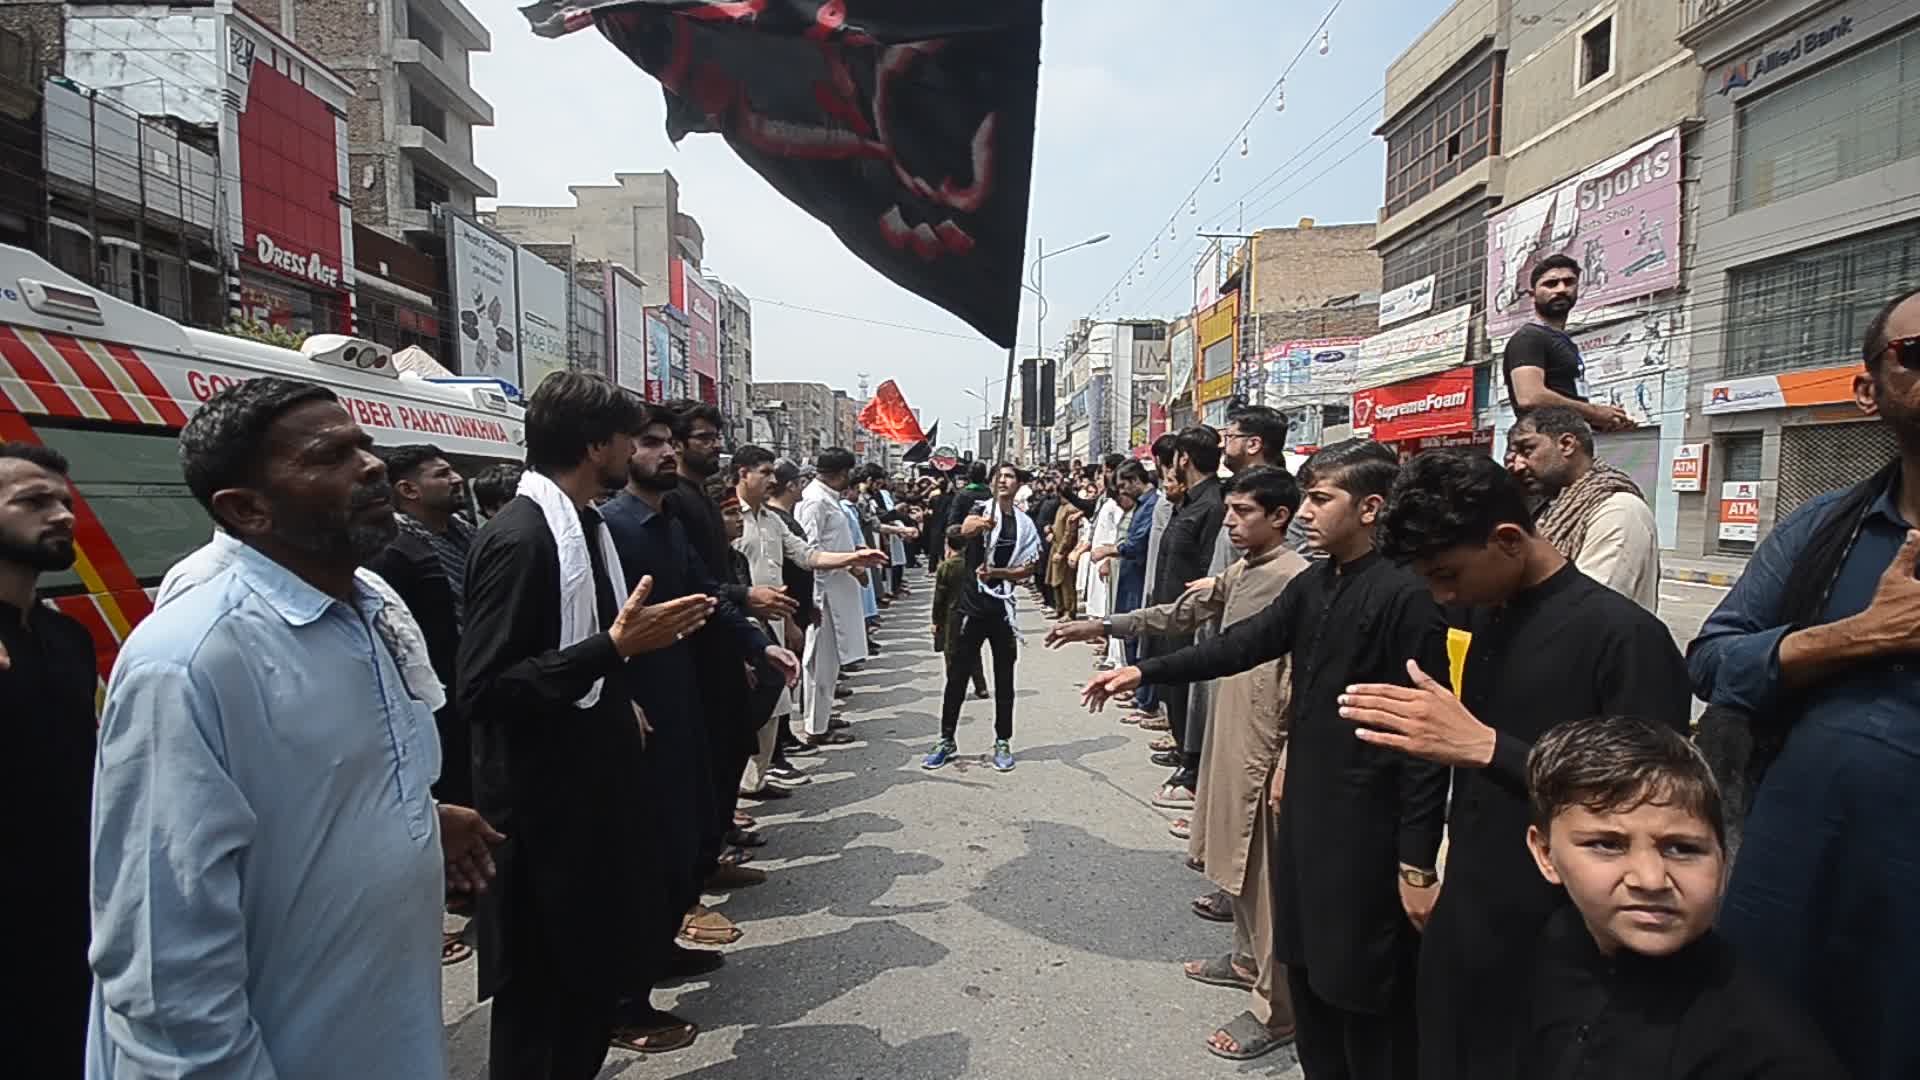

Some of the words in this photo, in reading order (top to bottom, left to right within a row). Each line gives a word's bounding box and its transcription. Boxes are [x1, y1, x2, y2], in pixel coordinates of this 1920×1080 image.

[1753, 40, 1801, 79] Allied
[1804, 16, 1853, 54] Bank
[1580, 151, 1671, 212] Sports
[340, 396, 397, 429] YBER
[397, 405, 507, 448] PAKHTUNKHWA
[1375, 391, 1466, 422] SupremeFoam
[1674, 461, 1697, 475] ATM
[1729, 502, 1758, 517] ATM
